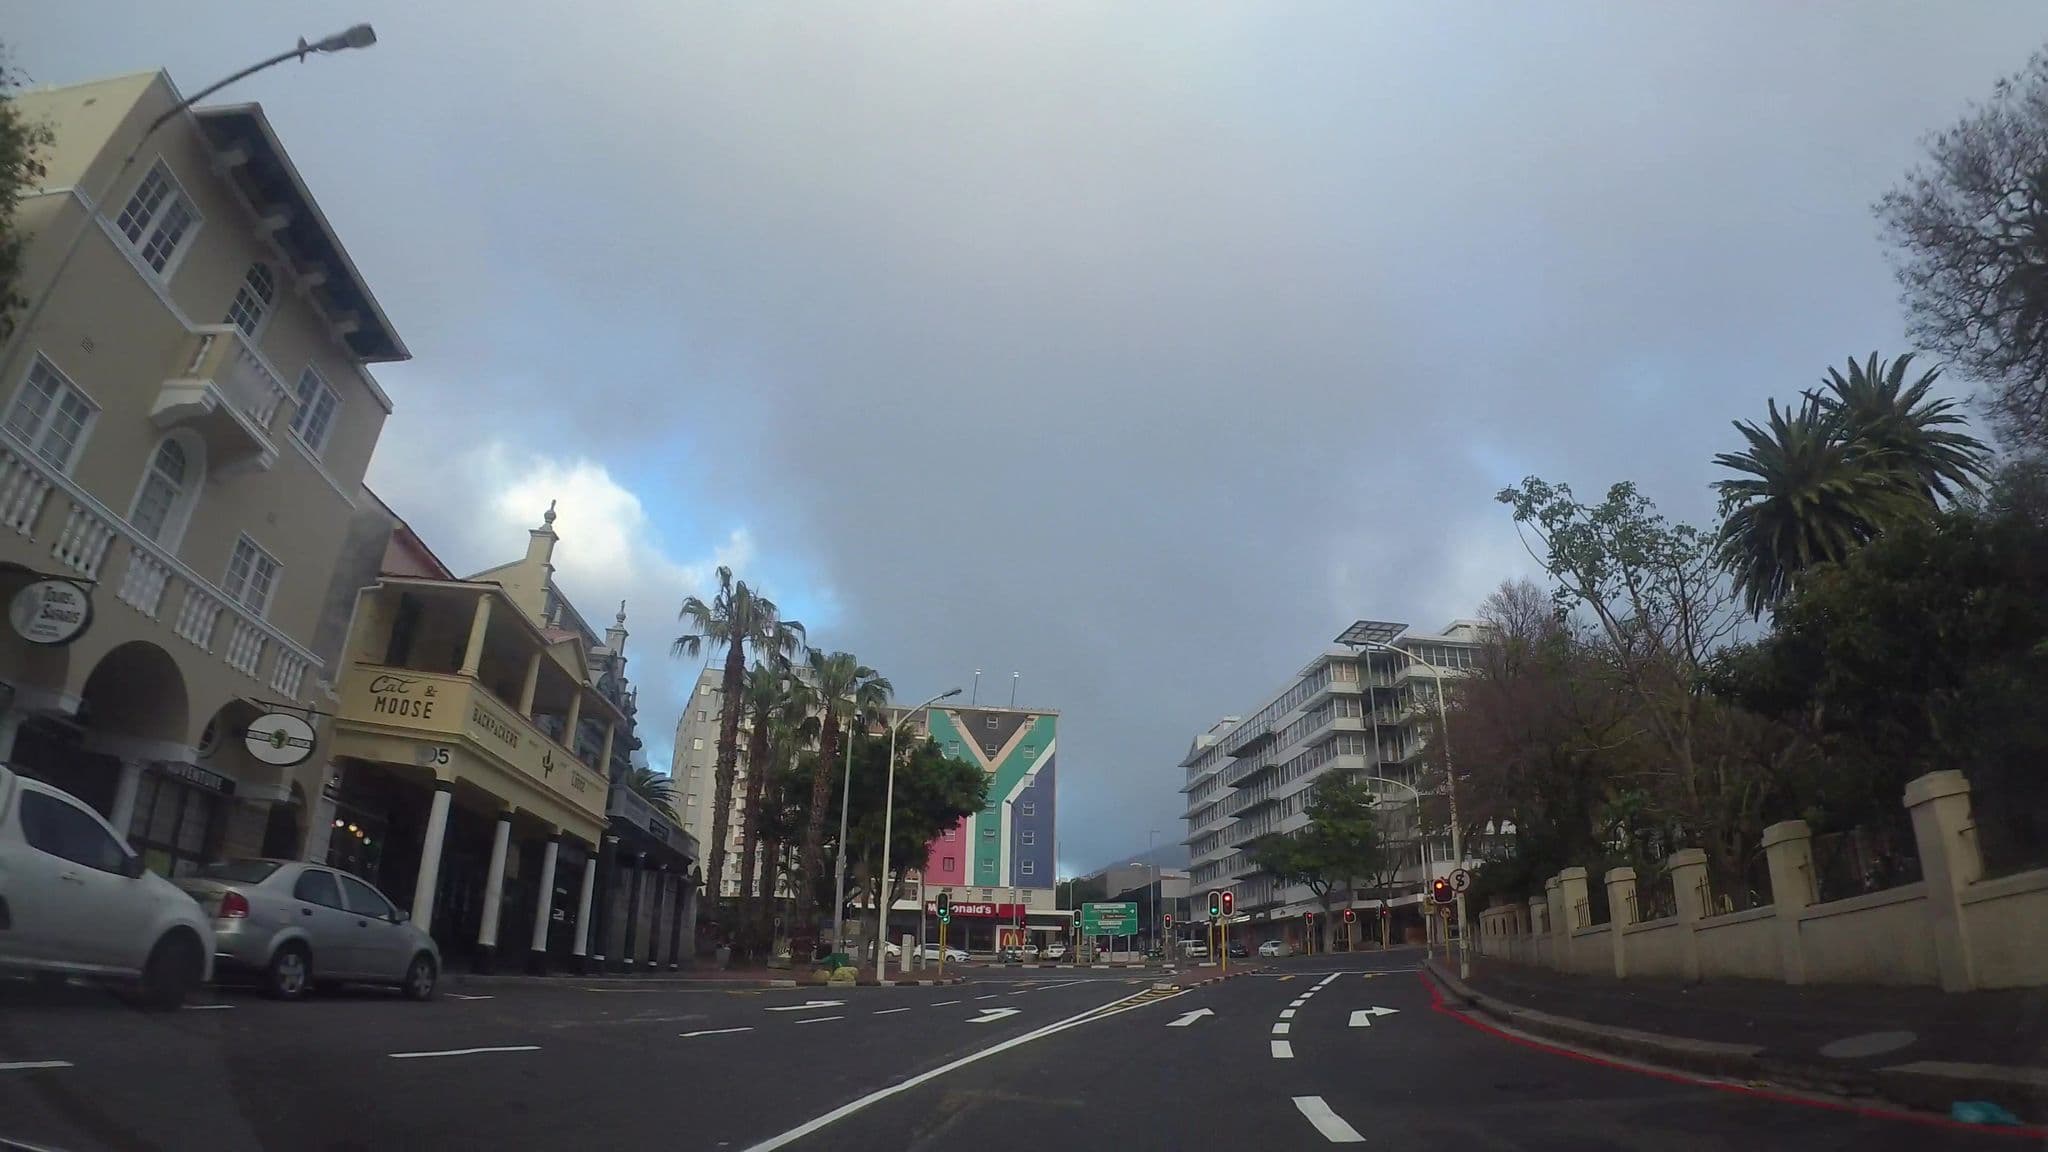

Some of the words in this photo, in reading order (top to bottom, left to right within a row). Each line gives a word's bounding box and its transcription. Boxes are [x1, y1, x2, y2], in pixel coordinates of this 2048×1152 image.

[369, 675, 420, 693] Cat
[374, 696, 433, 719] MOOSE
[472, 707, 518, 749] BACKPACKERS
